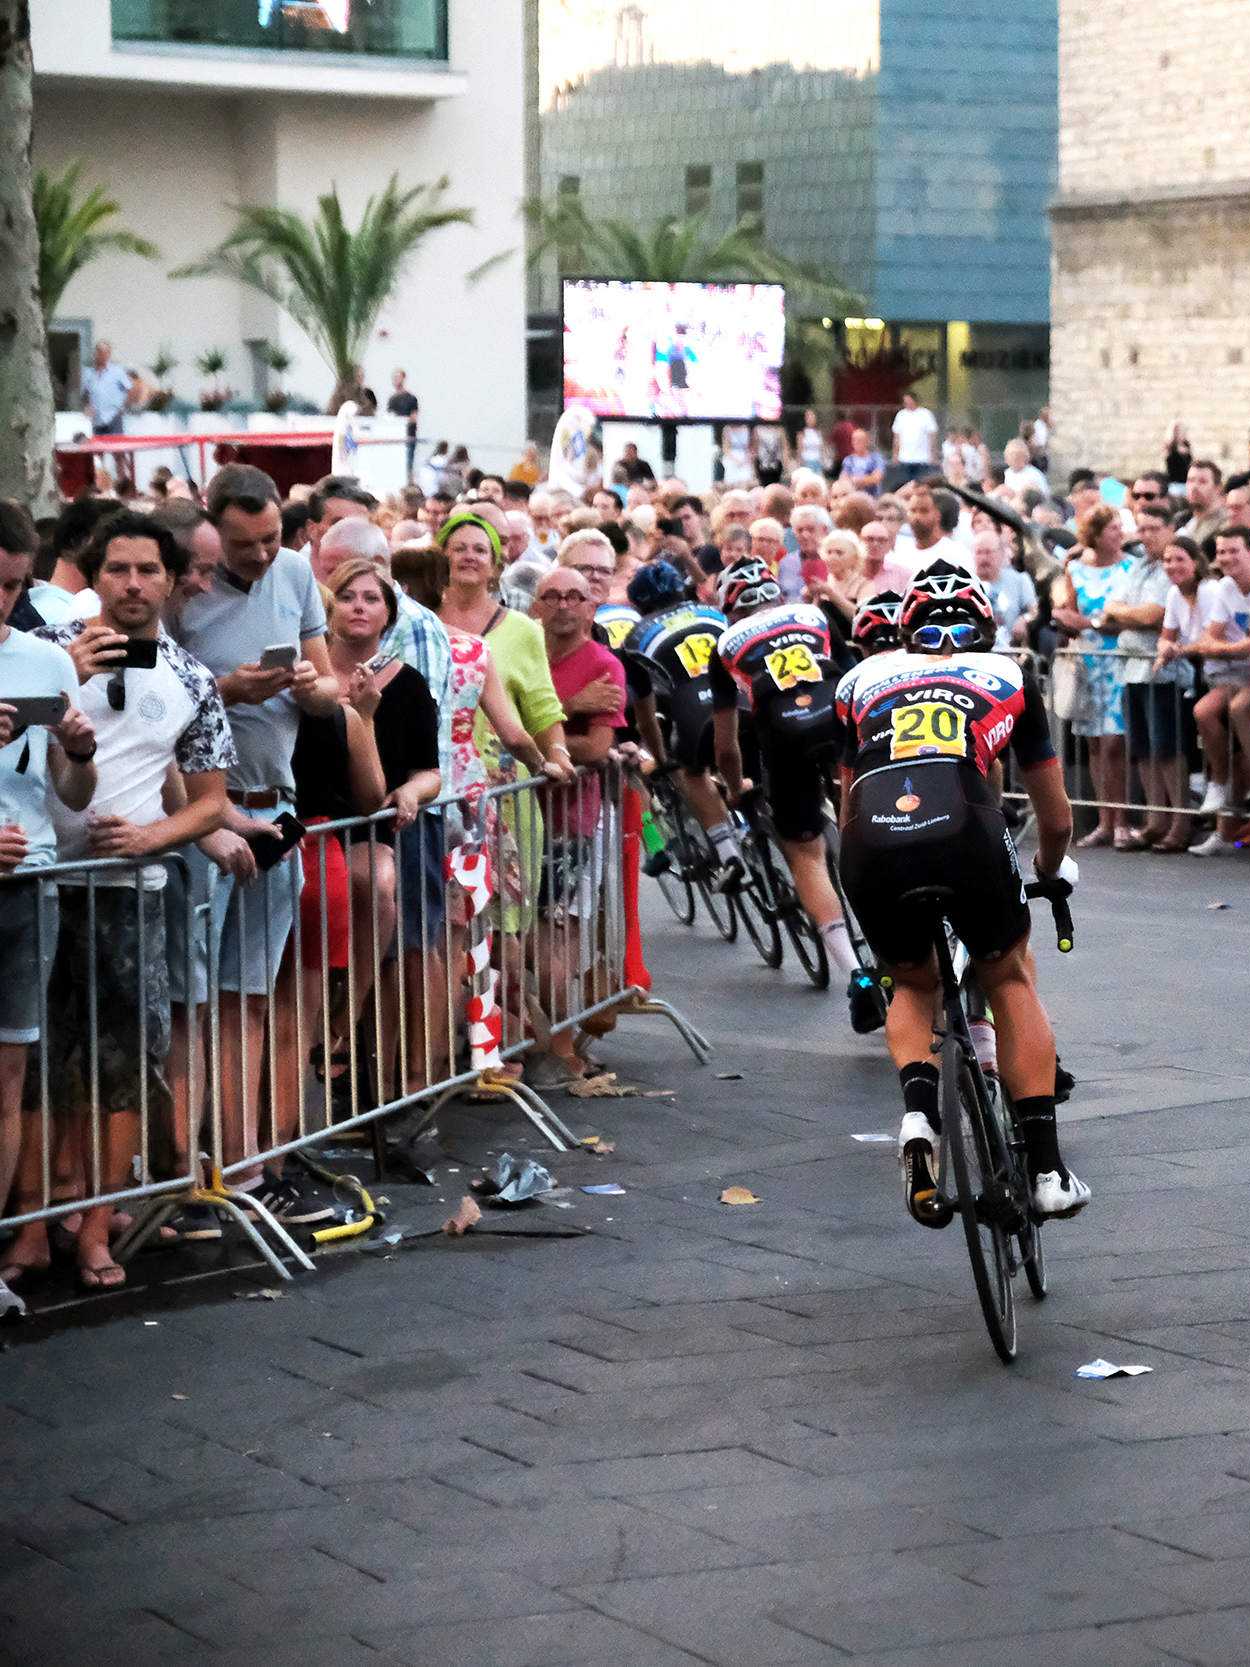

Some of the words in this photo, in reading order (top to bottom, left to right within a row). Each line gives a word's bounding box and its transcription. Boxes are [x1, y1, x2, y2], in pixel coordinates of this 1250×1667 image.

[769, 633, 816, 648] VIRO
[771, 648, 811, 679] 23
[904, 688, 975, 710] VIRO
[896, 707, 959, 742] 20
[982, 713, 1014, 751] VIRO
[871, 814, 911, 824] Rabobank
